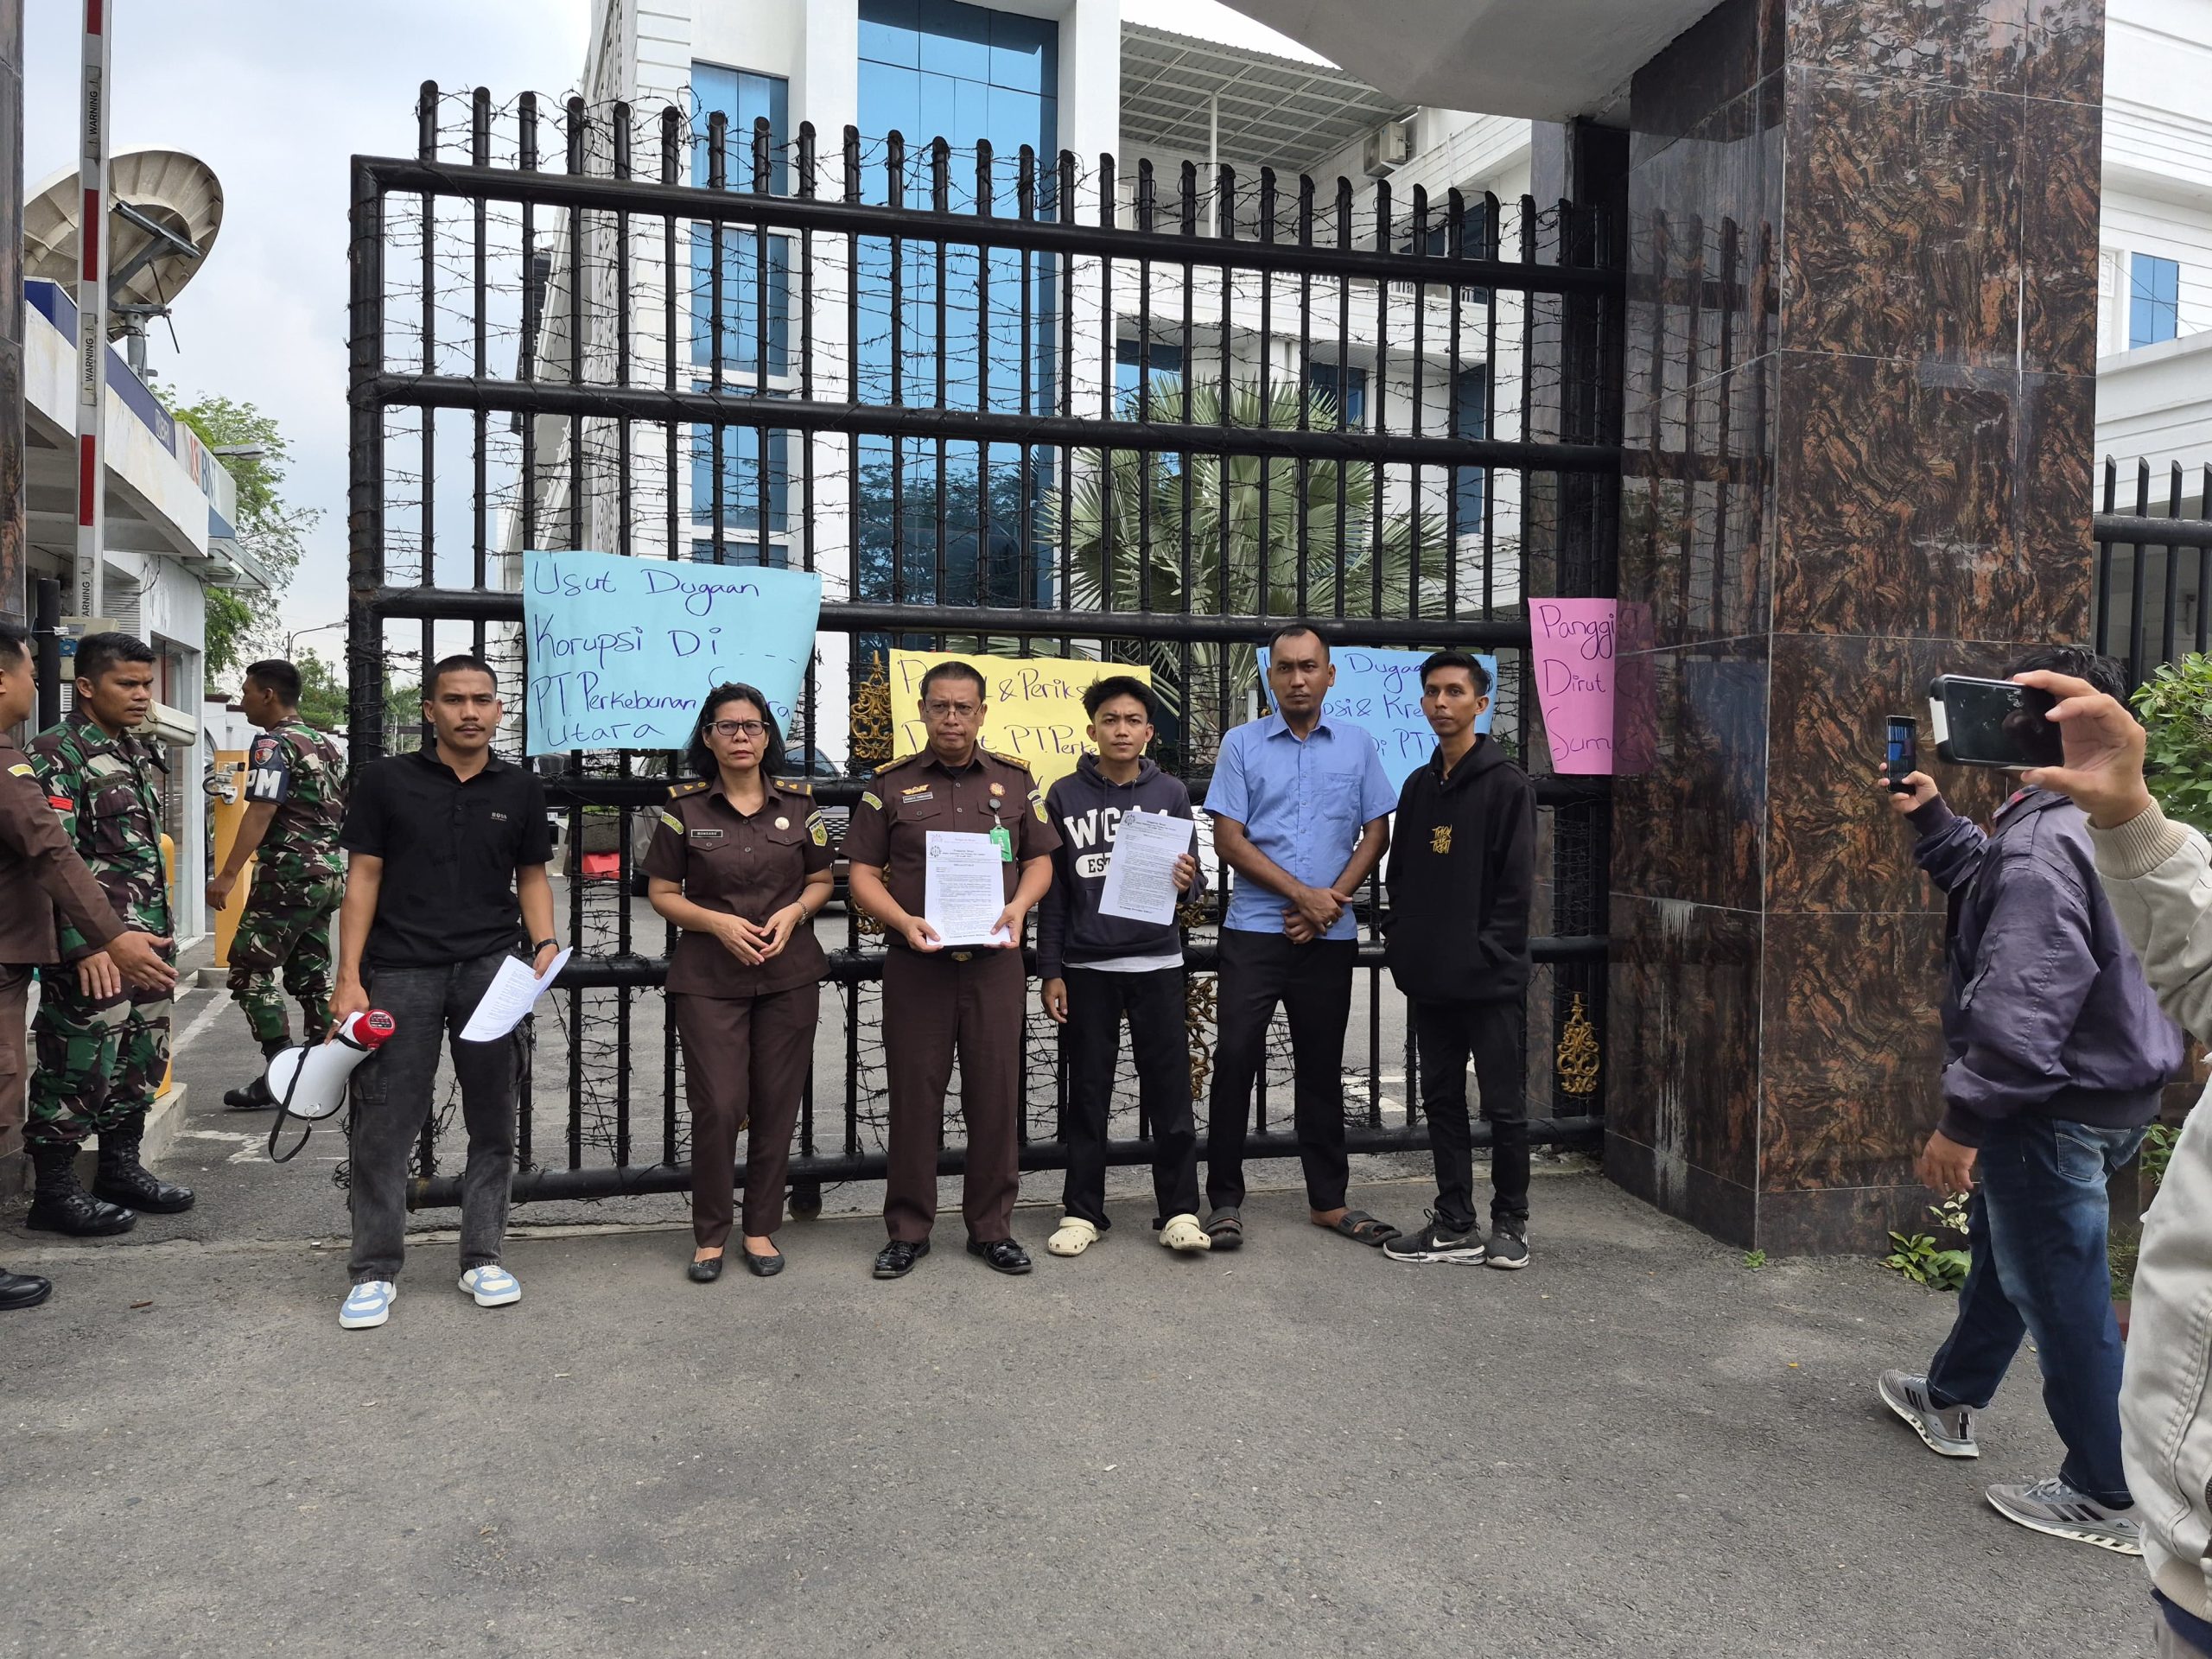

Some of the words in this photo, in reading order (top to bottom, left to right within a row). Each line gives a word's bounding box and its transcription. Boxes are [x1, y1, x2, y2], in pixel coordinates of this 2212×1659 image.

[89, 91, 98, 135] WARNING
[85, 338, 94, 382] WARNING
[201, 449, 216, 506] BNI
[82, 581, 91, 617] ARNING
[534, 561, 617, 596] Usut
[641, 569, 760, 616] Dugaan
[534, 613, 643, 670] Korupsi
[668, 626, 721, 657] Di
[1539, 605, 1616, 660] Panggi
[1018, 668, 1088, 701] Periks
[1344, 653, 1424, 694] Dugaa
[1543, 658, 1605, 696] Dirut
[1383, 694, 1425, 720] Kre
[247, 768, 282, 798] PM
[1064, 805, 1167, 849] WG
